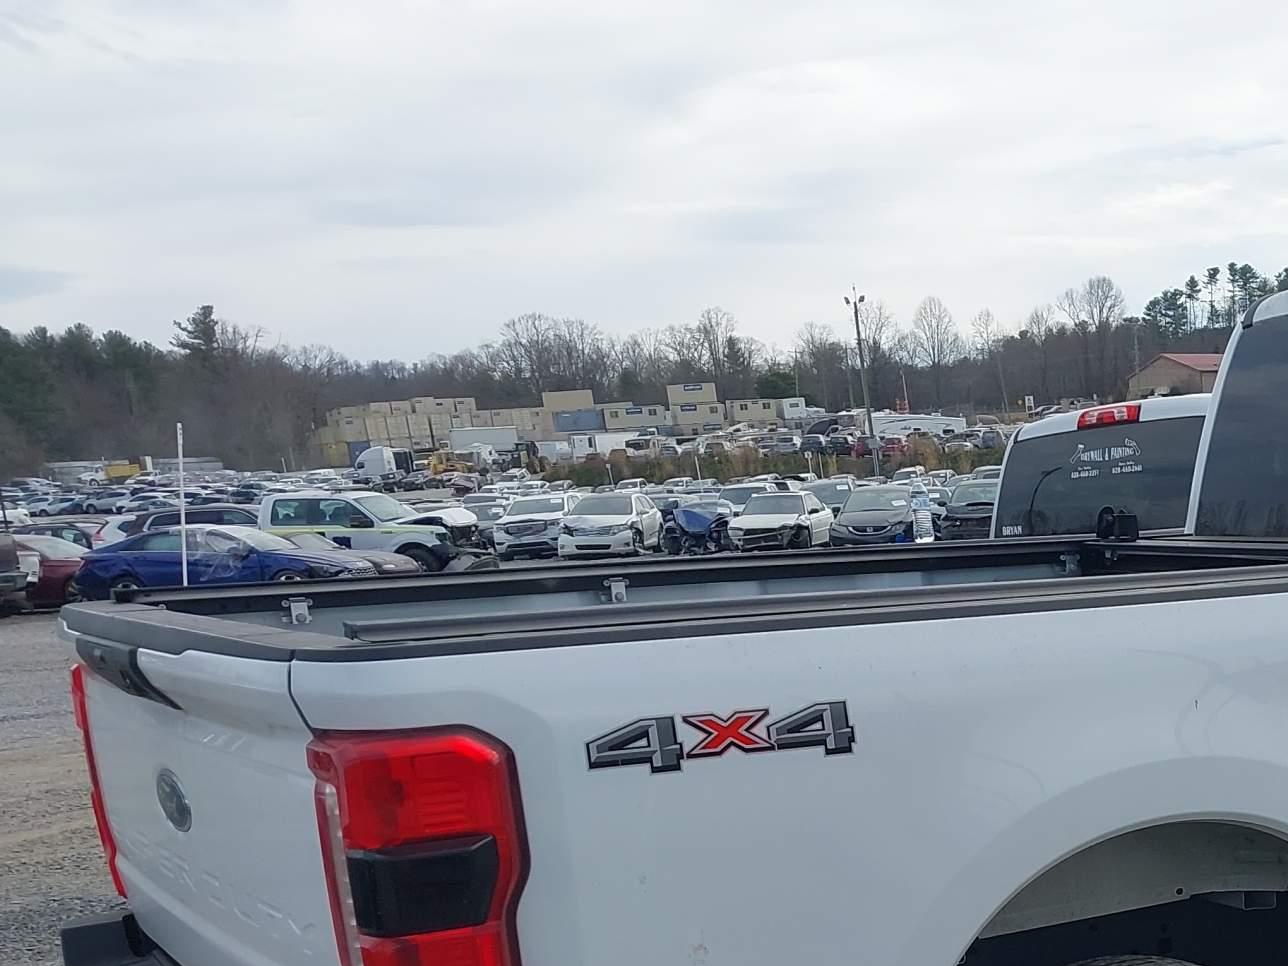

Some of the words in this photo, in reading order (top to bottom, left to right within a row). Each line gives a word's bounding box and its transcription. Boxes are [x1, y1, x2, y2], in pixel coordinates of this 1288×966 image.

[1080, 448, 1103, 461] DRYWALL
[1110, 446, 1135, 460] PAINTING
[1002, 525, 1022, 536] BRYAN
